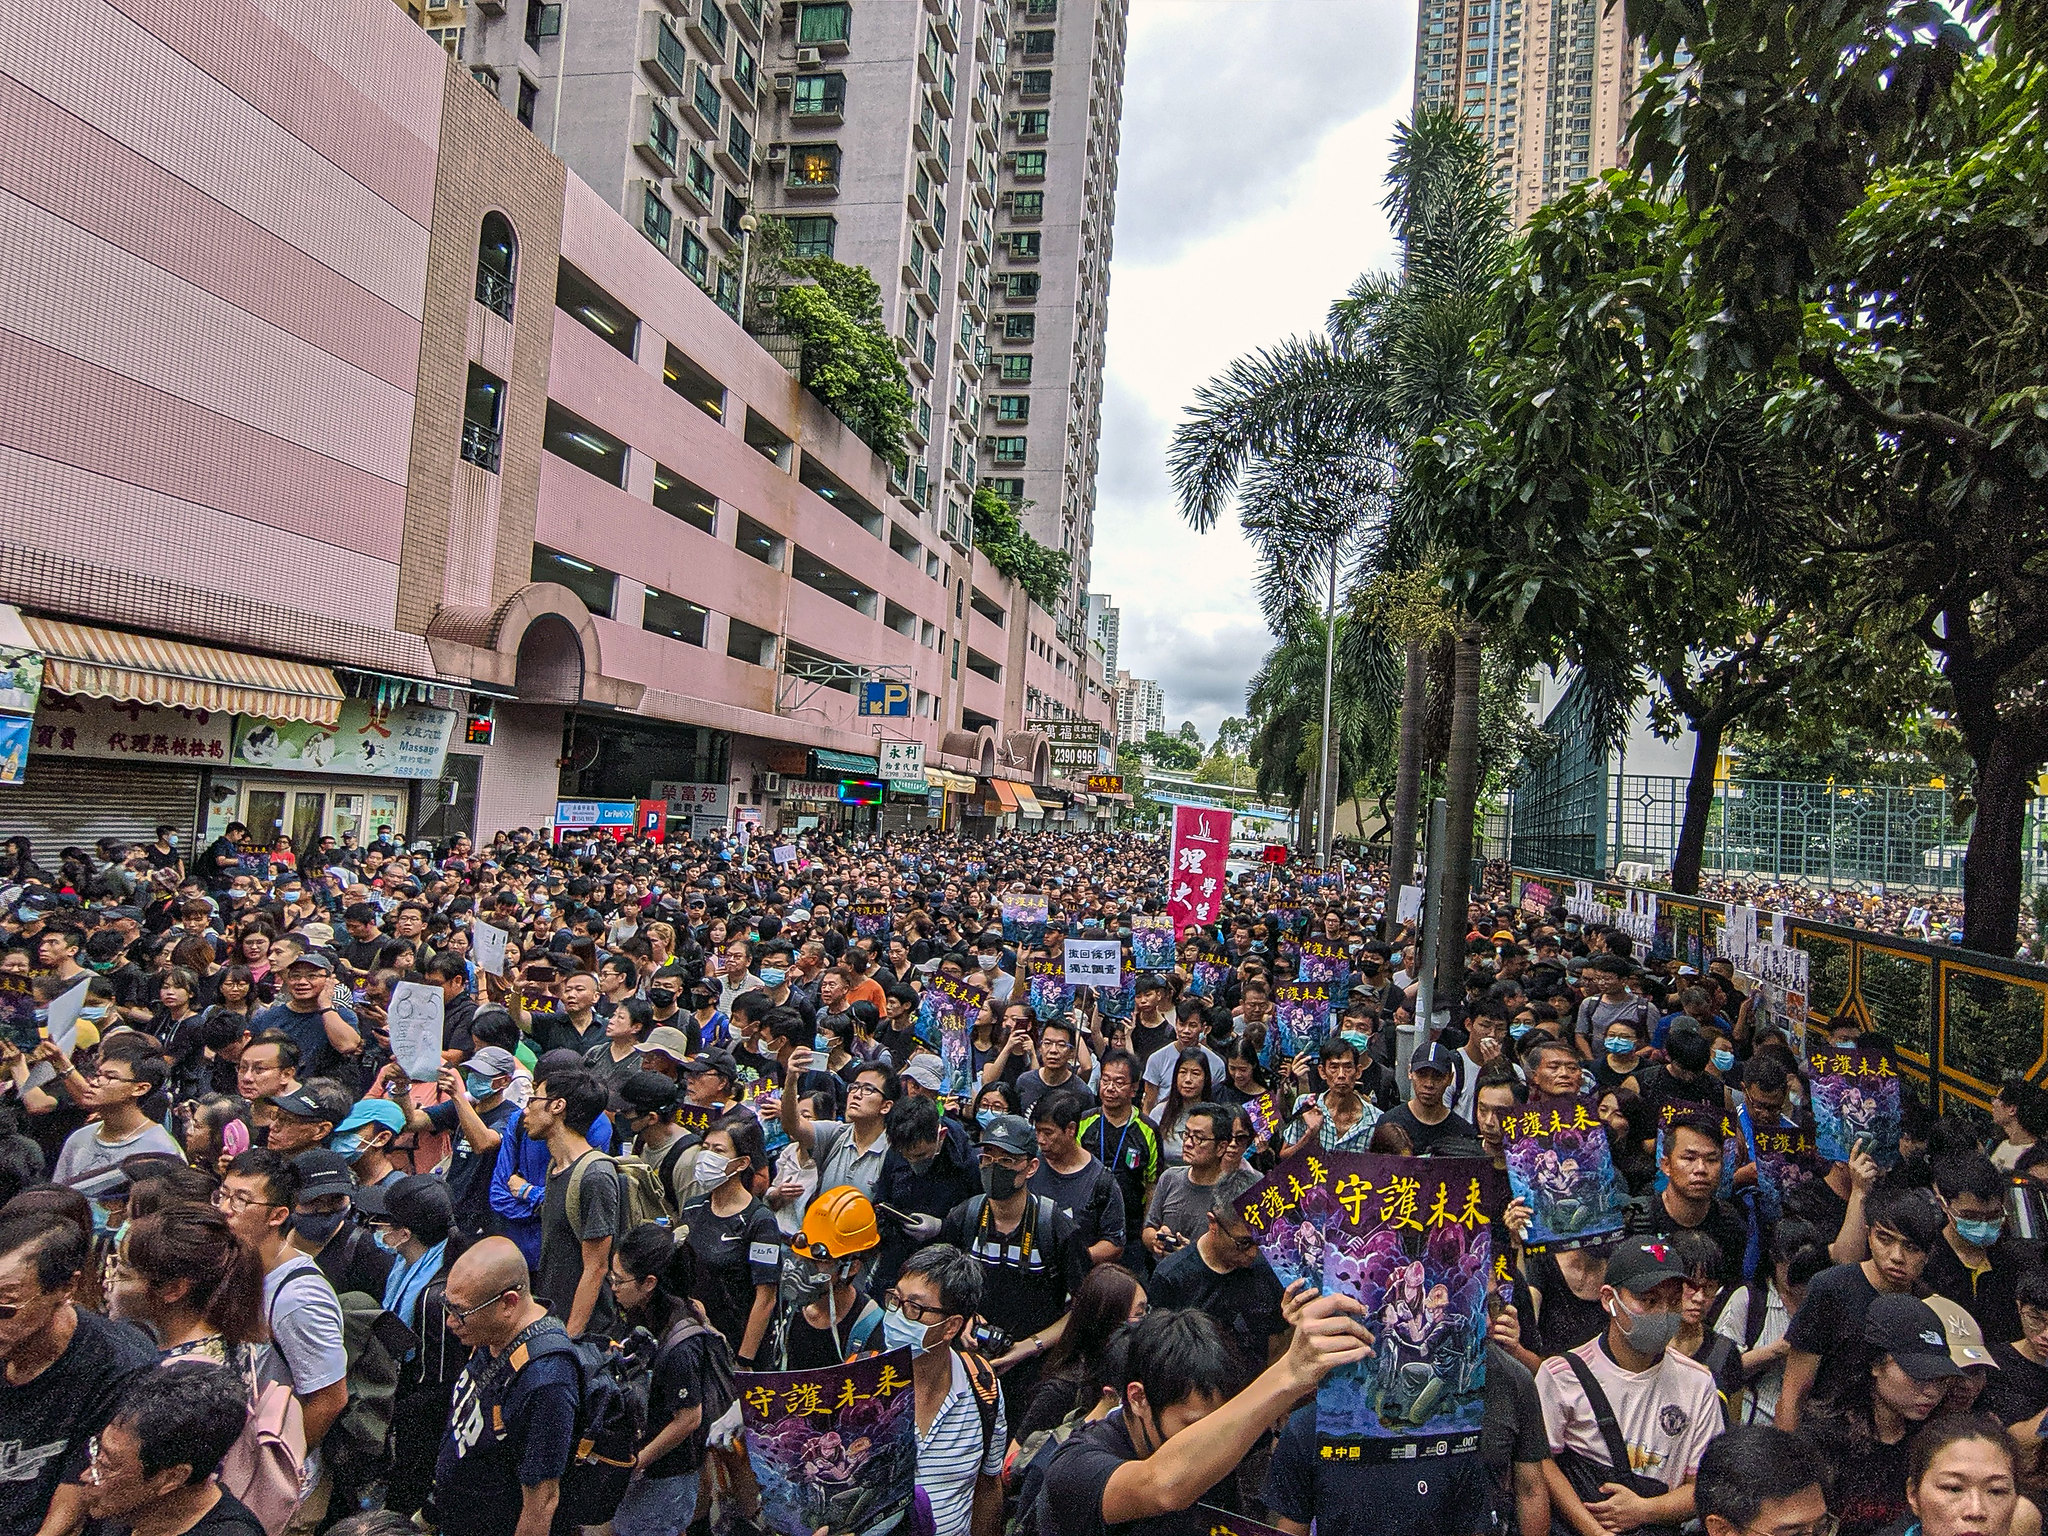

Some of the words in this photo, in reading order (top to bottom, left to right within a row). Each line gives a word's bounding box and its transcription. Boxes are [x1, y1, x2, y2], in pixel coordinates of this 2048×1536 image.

[884, 685, 908, 714] P
[399, 740, 440, 756] Massage
[889, 745, 917, 760] 永利
[1055, 748, 1076, 764] 2390
[1077, 749, 1097, 765] 9961
[648, 814, 657, 827] P
